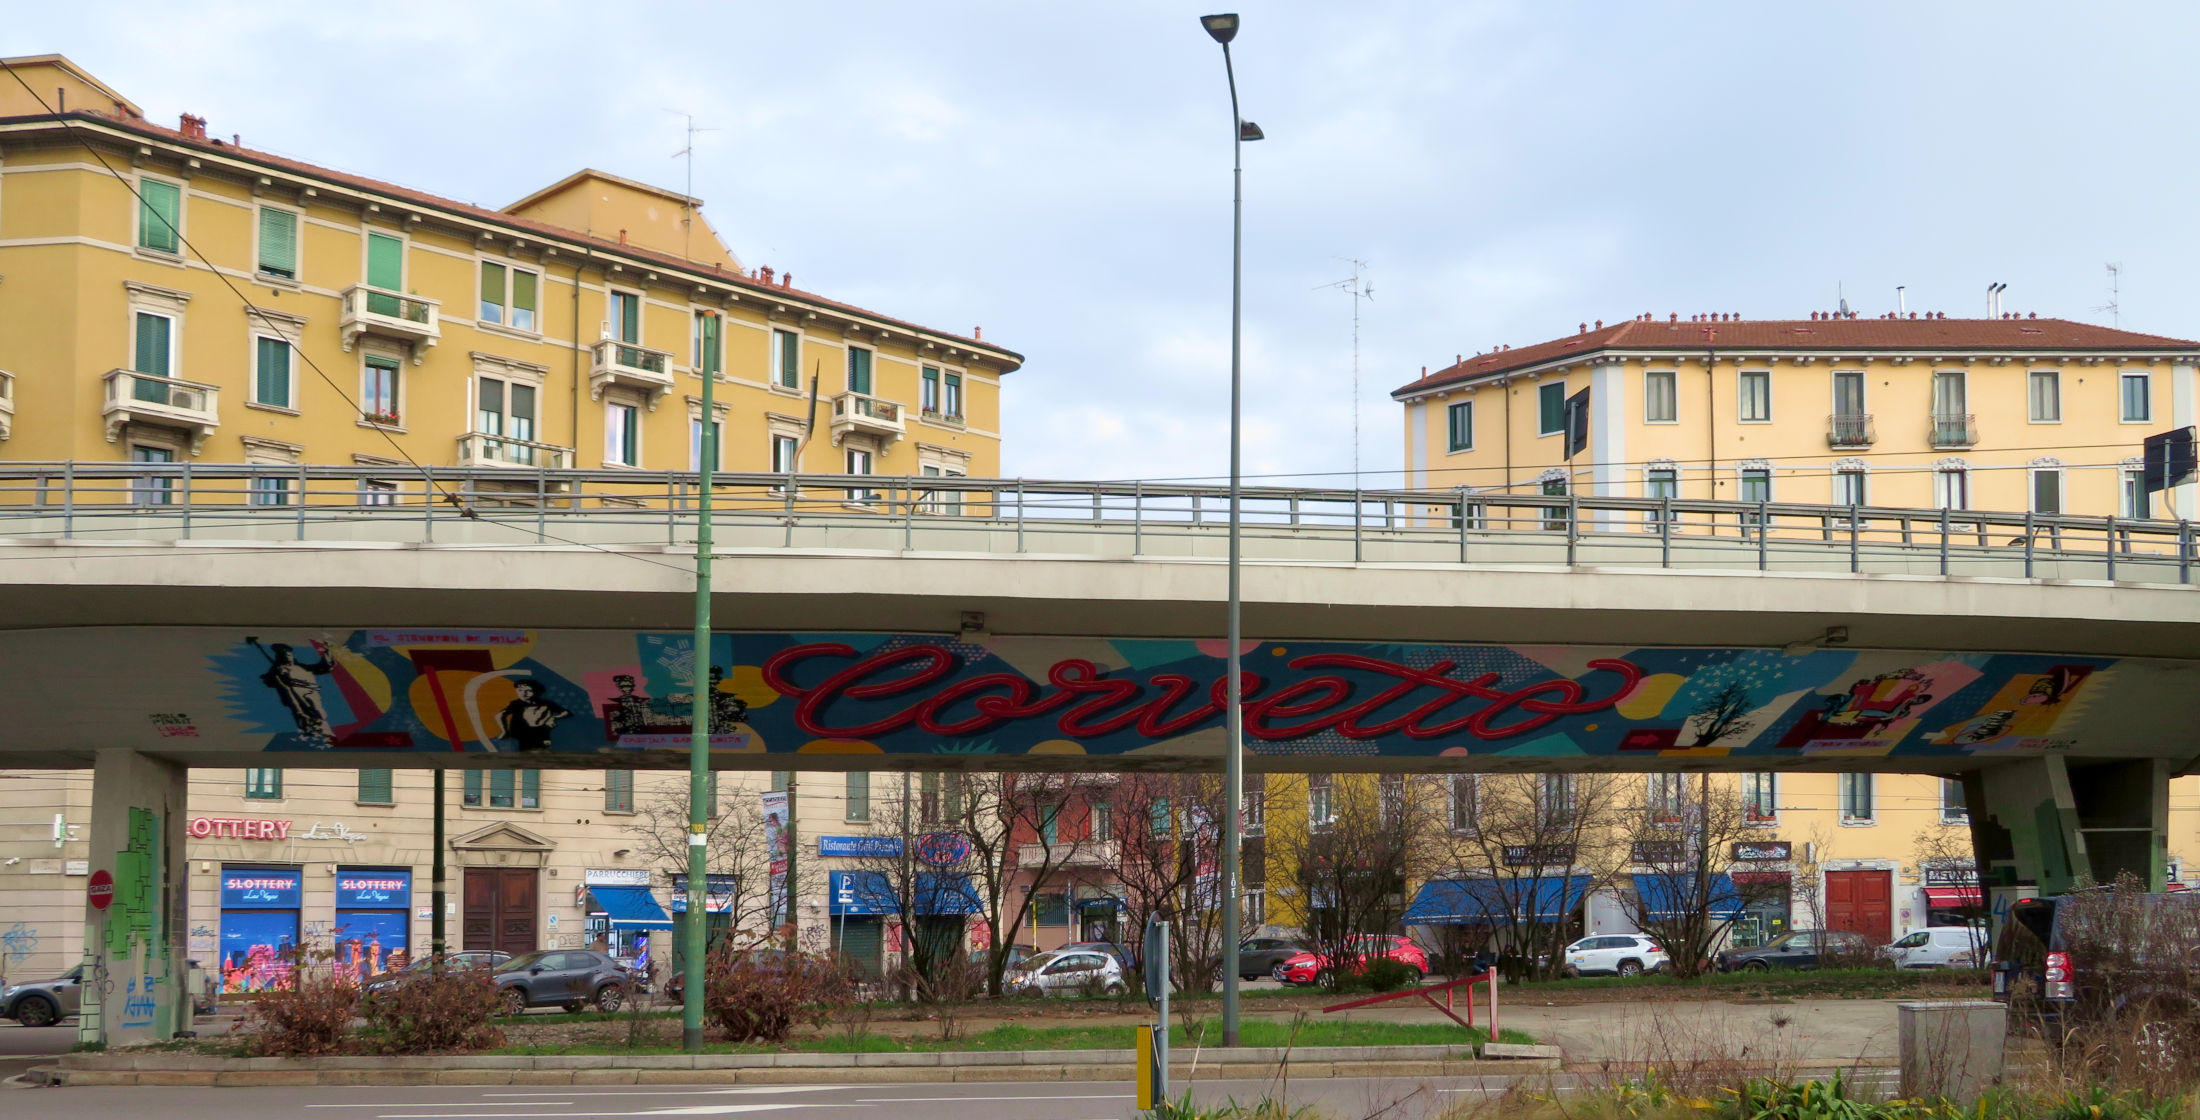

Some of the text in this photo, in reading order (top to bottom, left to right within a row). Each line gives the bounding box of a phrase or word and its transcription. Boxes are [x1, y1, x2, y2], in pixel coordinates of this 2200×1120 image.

[761, 641, 1642, 740] Corvetto
[186, 817, 293, 840] OTTERY
[823, 839, 857, 851] Ristorante
[587, 870, 649, 879] PARRUCCHIERE
[227, 879, 294, 890] SLOTTERY
[342, 879, 404, 890] SLOTTERY
